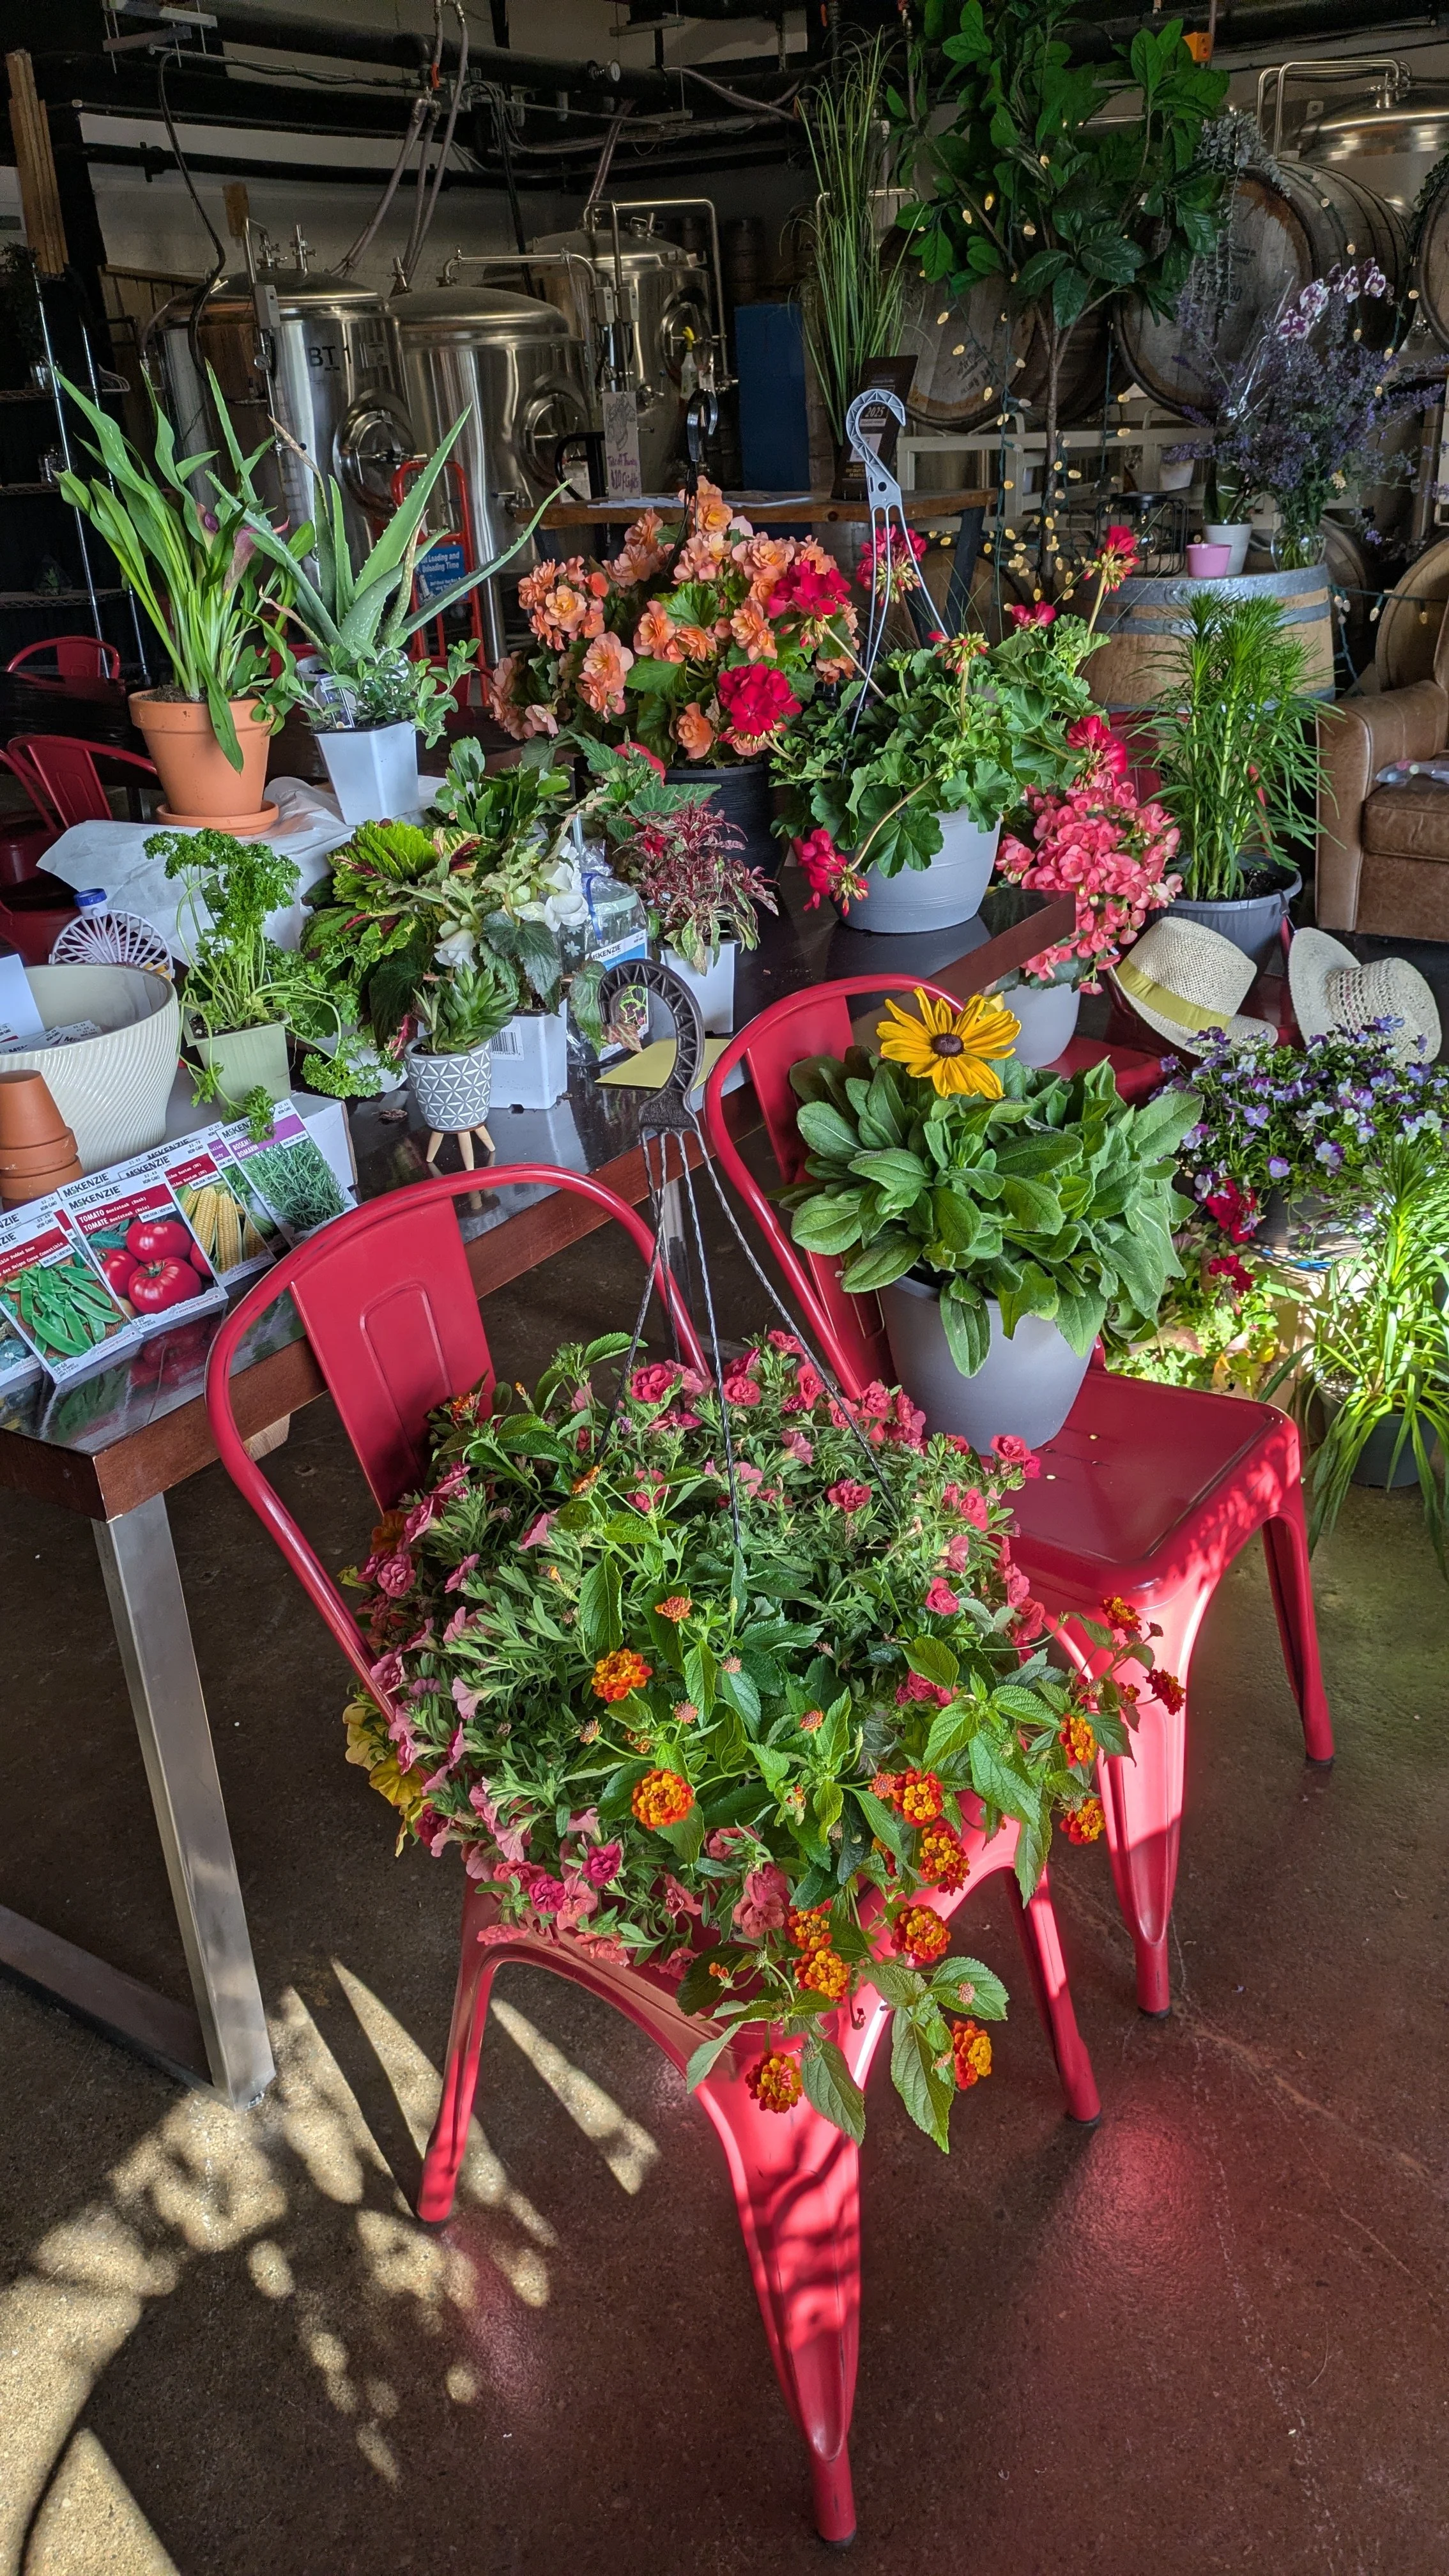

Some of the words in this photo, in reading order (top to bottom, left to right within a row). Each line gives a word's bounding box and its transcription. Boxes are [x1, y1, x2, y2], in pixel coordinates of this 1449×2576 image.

[307, 345, 335, 367] BT
[864, 406, 886, 418] 2025
[428, 553, 448, 563] Loading
[449, 551, 460, 560] and
[422, 563, 445, 574] Unloading
[445, 562, 459, 570] Time
[232, 1137, 253, 1151] ROSEMA
[236, 1144, 259, 1158] ROMARIN
[40, 1200, 58, 1212] NON-GMO
[79, 1209, 105, 1224] TOMATO
[105, 1202, 130, 1215] Beefsteak
[36, 1218, 54, 1229] NON-GMO
[83, 1217, 109, 1232] TOMATE
[109, 1211, 134, 1223] Beefsteak
[39, 1242, 64, 1257] Comestible
